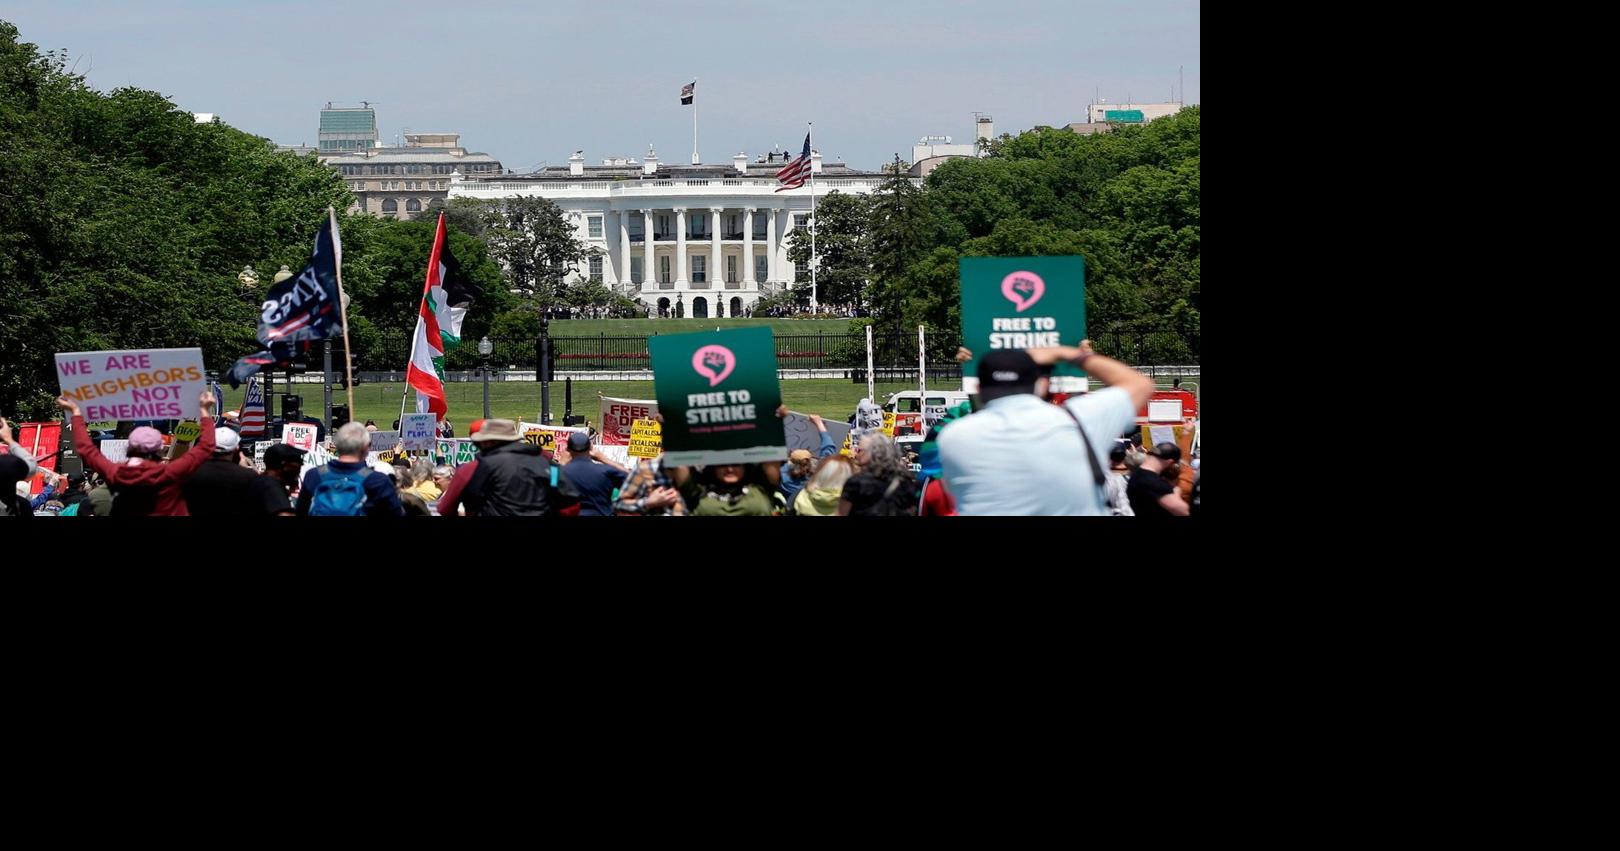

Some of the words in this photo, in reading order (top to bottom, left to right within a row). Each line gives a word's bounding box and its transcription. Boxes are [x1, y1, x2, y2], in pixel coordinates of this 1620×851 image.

[992, 318, 1031, 331] FREE
[1033, 316, 1056, 330] TO
[989, 331, 1060, 349] STRIKE
[59, 359, 92, 376] WE
[105, 354, 152, 371] ARE
[63, 366, 202, 401] NEIGHBORS
[132, 385, 182, 402] NOT
[687, 391, 726, 407] FREE
[727, 389, 751, 404] TO
[86, 402, 182, 420] ENEMIES
[610, 404, 649, 416] FREE
[685, 404, 757, 424] STRIKE
[460, 442, 479, 453] NO
[525, 433, 553, 447] STOP
